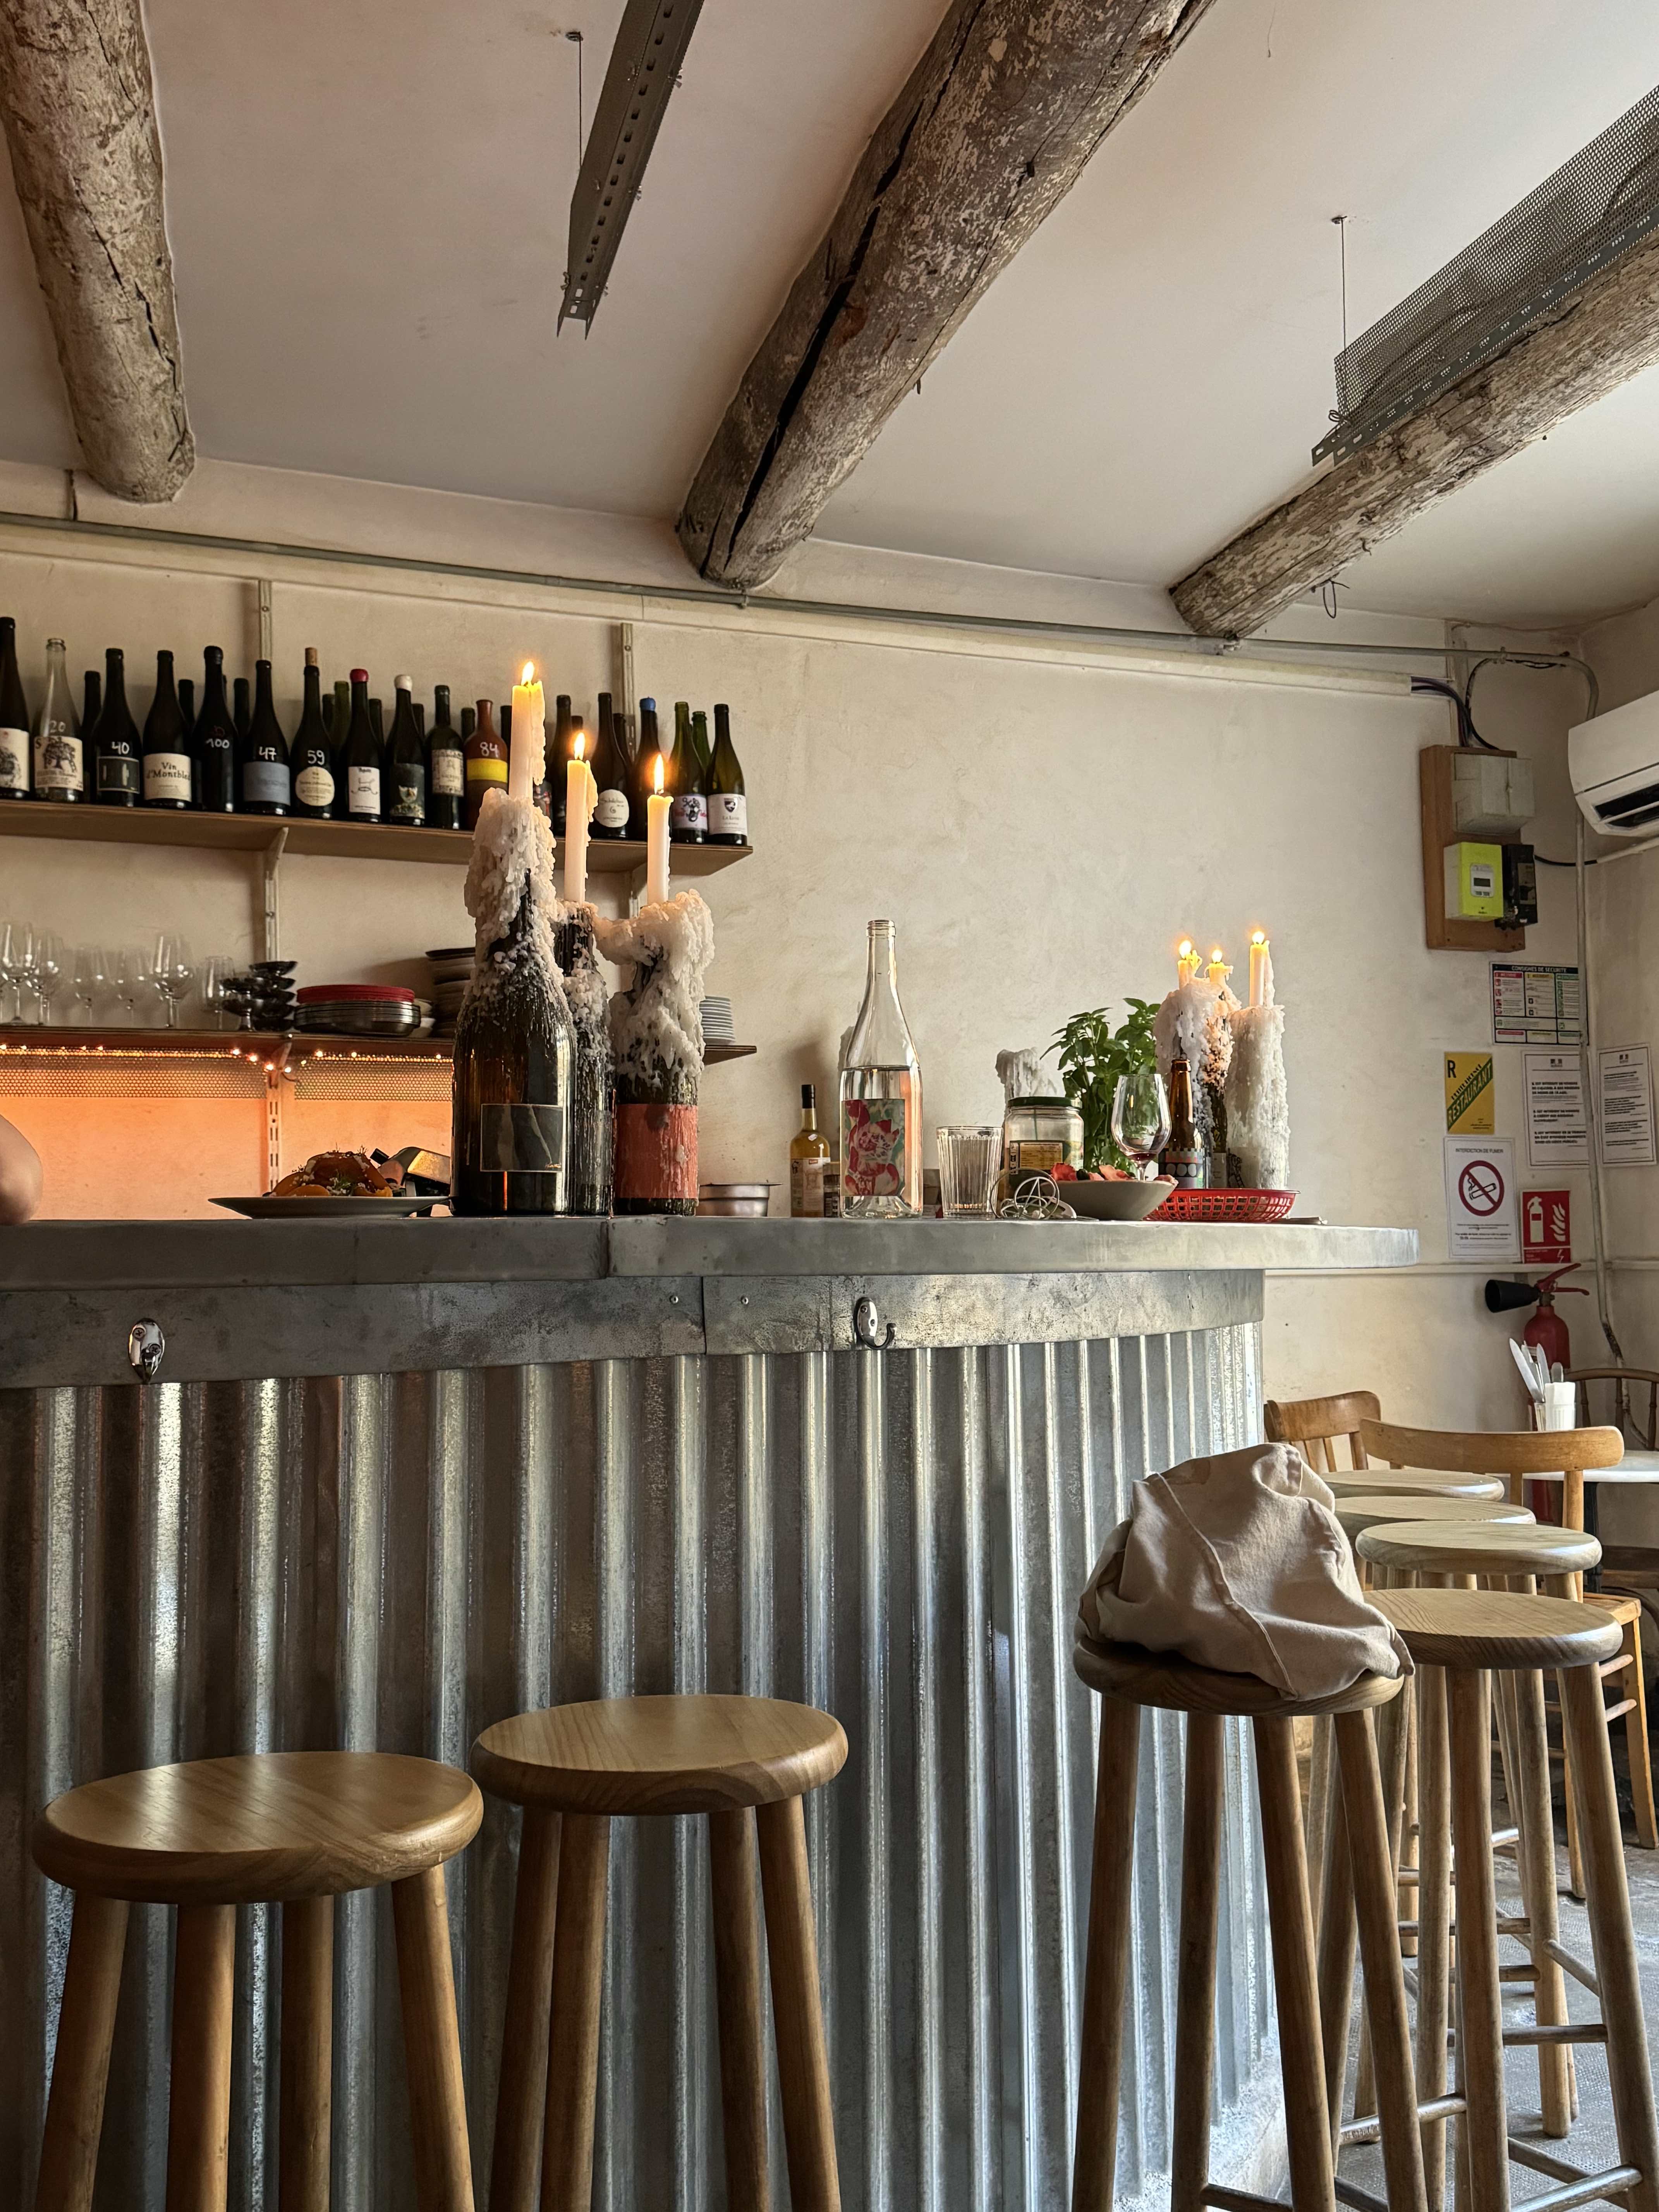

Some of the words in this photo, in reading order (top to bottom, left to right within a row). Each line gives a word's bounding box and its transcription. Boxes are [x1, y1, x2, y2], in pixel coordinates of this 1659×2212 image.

[49, 720, 66, 733] 20
[112, 741, 130, 754] 40
[206, 738, 230, 749] 100
[480, 741, 500, 758] 84
[259, 746, 276, 761] 47
[307, 750, 325, 765] 59
[161, 762, 177, 770] Vin
[1447, 1060, 1456, 1078] R
[1448, 1062, 1491, 1127] RESTAURANT
